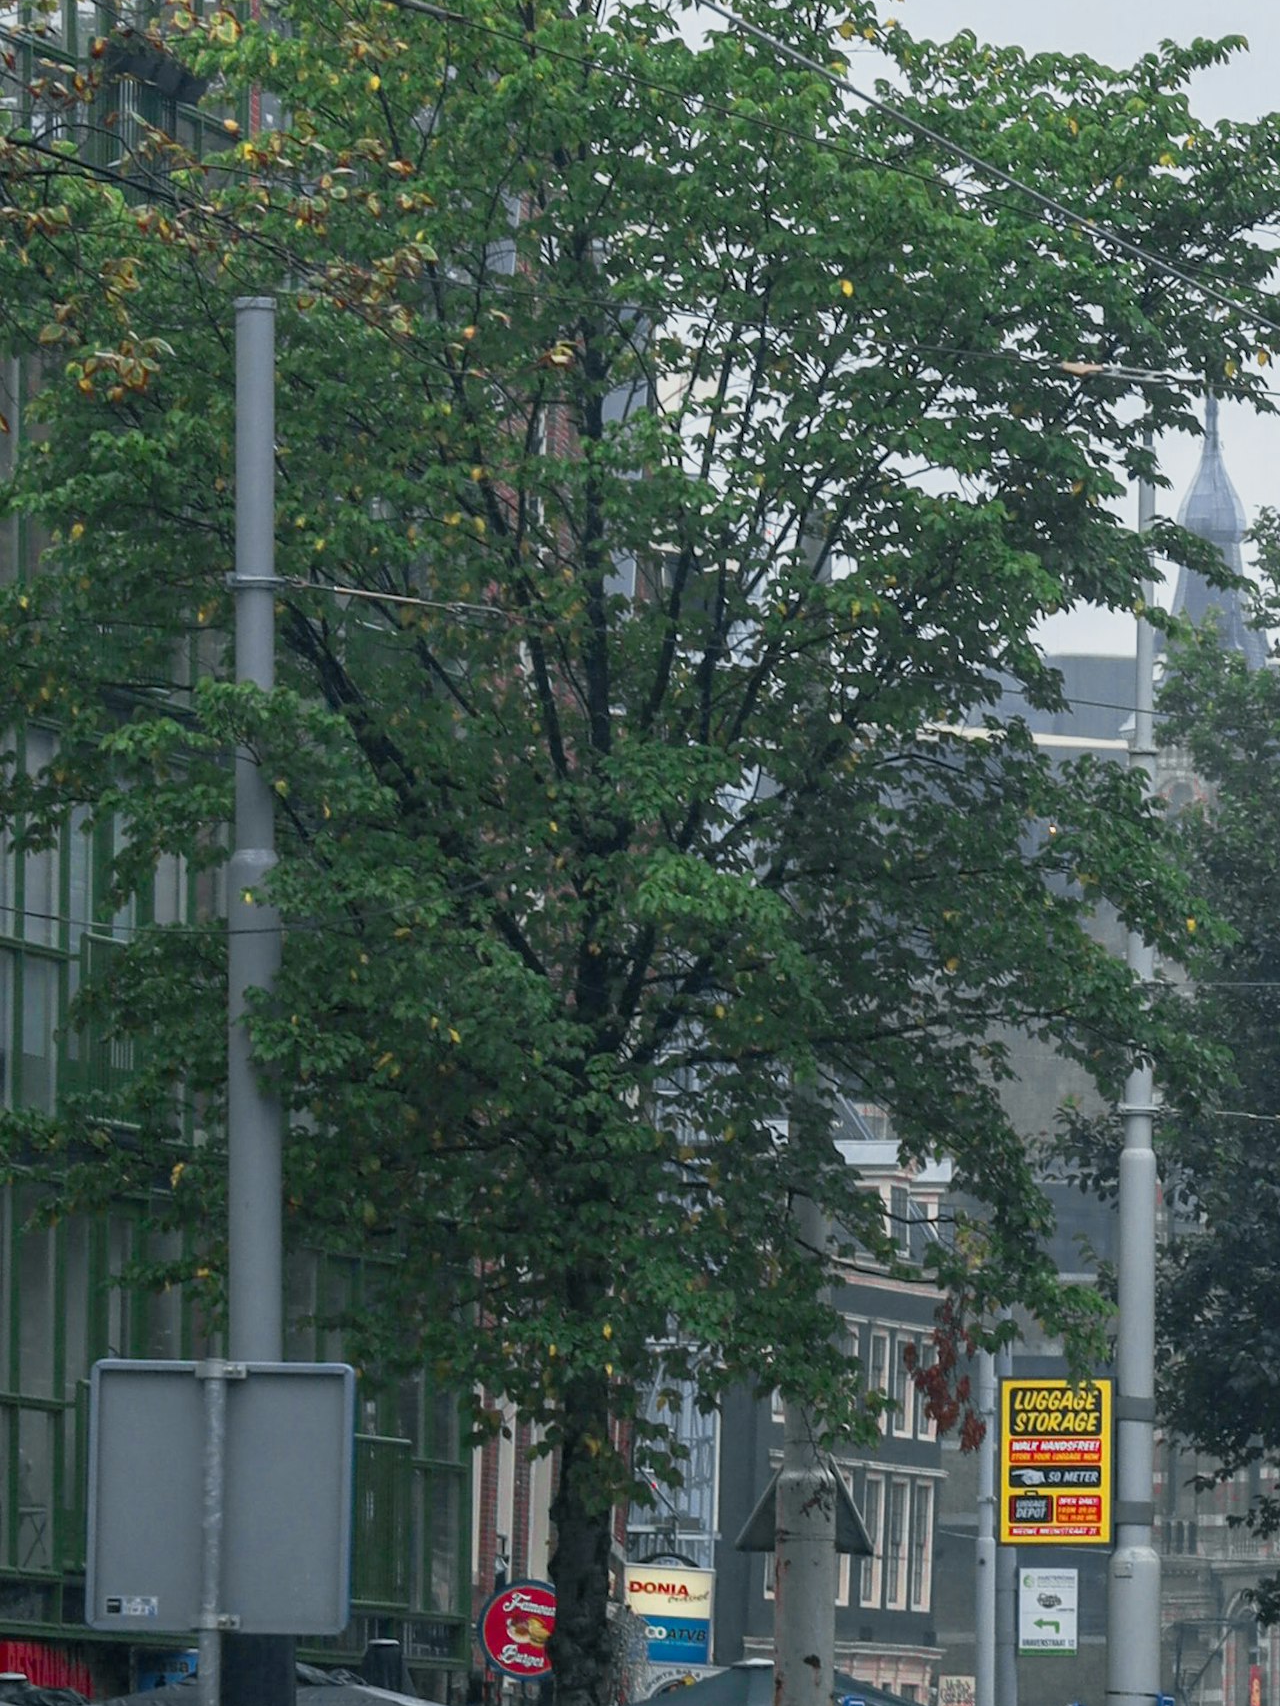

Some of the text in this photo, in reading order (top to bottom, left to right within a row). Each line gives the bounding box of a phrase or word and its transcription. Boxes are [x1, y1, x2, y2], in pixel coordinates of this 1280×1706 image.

[1014, 1390, 1099, 1410] LUGGAGE
[1014, 1412, 1100, 1432] STORAGE
[1012, 1441, 1039, 1451] WALK
[1063, 1471, 1099, 1483] METER
[1016, 1507, 1046, 1519] DEPOT
[629, 1580, 689, 1596] DONIA
[498, 1644, 544, 1668] Burger
